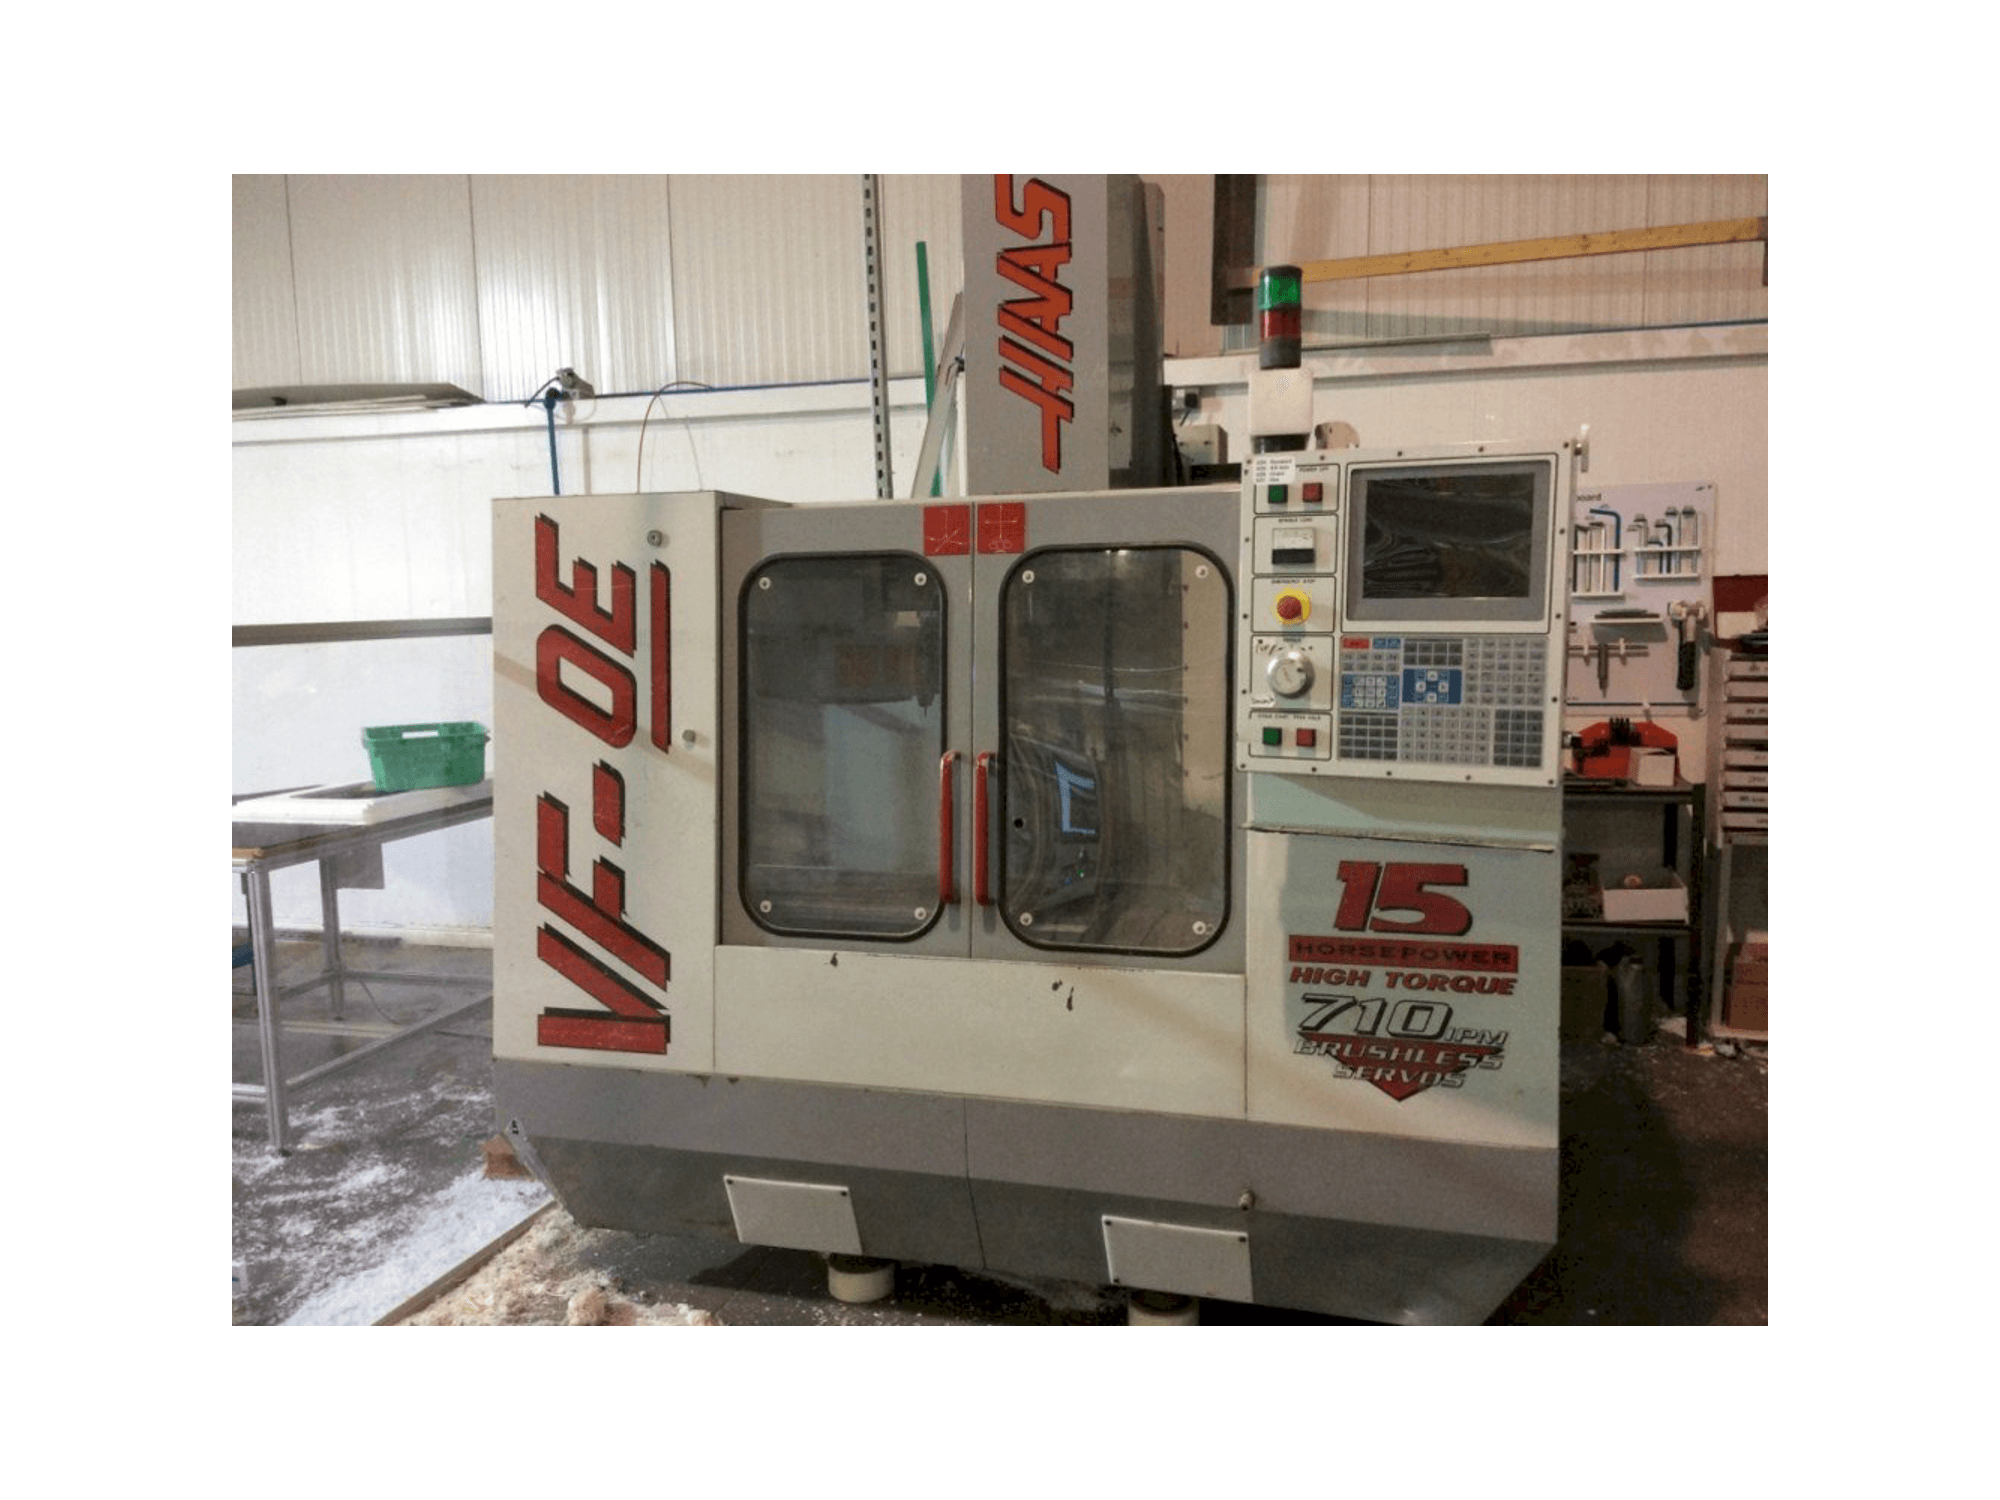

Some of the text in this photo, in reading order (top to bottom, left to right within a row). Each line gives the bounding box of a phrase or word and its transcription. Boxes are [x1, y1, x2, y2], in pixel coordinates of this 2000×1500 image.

[994, 174, 1075, 474] HAAS
[1334, 861, 1473, 937] 15
[1296, 941, 1511, 965] HORSEPOWER
[1289, 966, 1518, 995] HIGH TORQUE
[1299, 993, 1453, 1040] 710
[1293, 1039, 1504, 1071] BRUSHLESS
[1333, 1063, 1466, 1089] SERVOS
